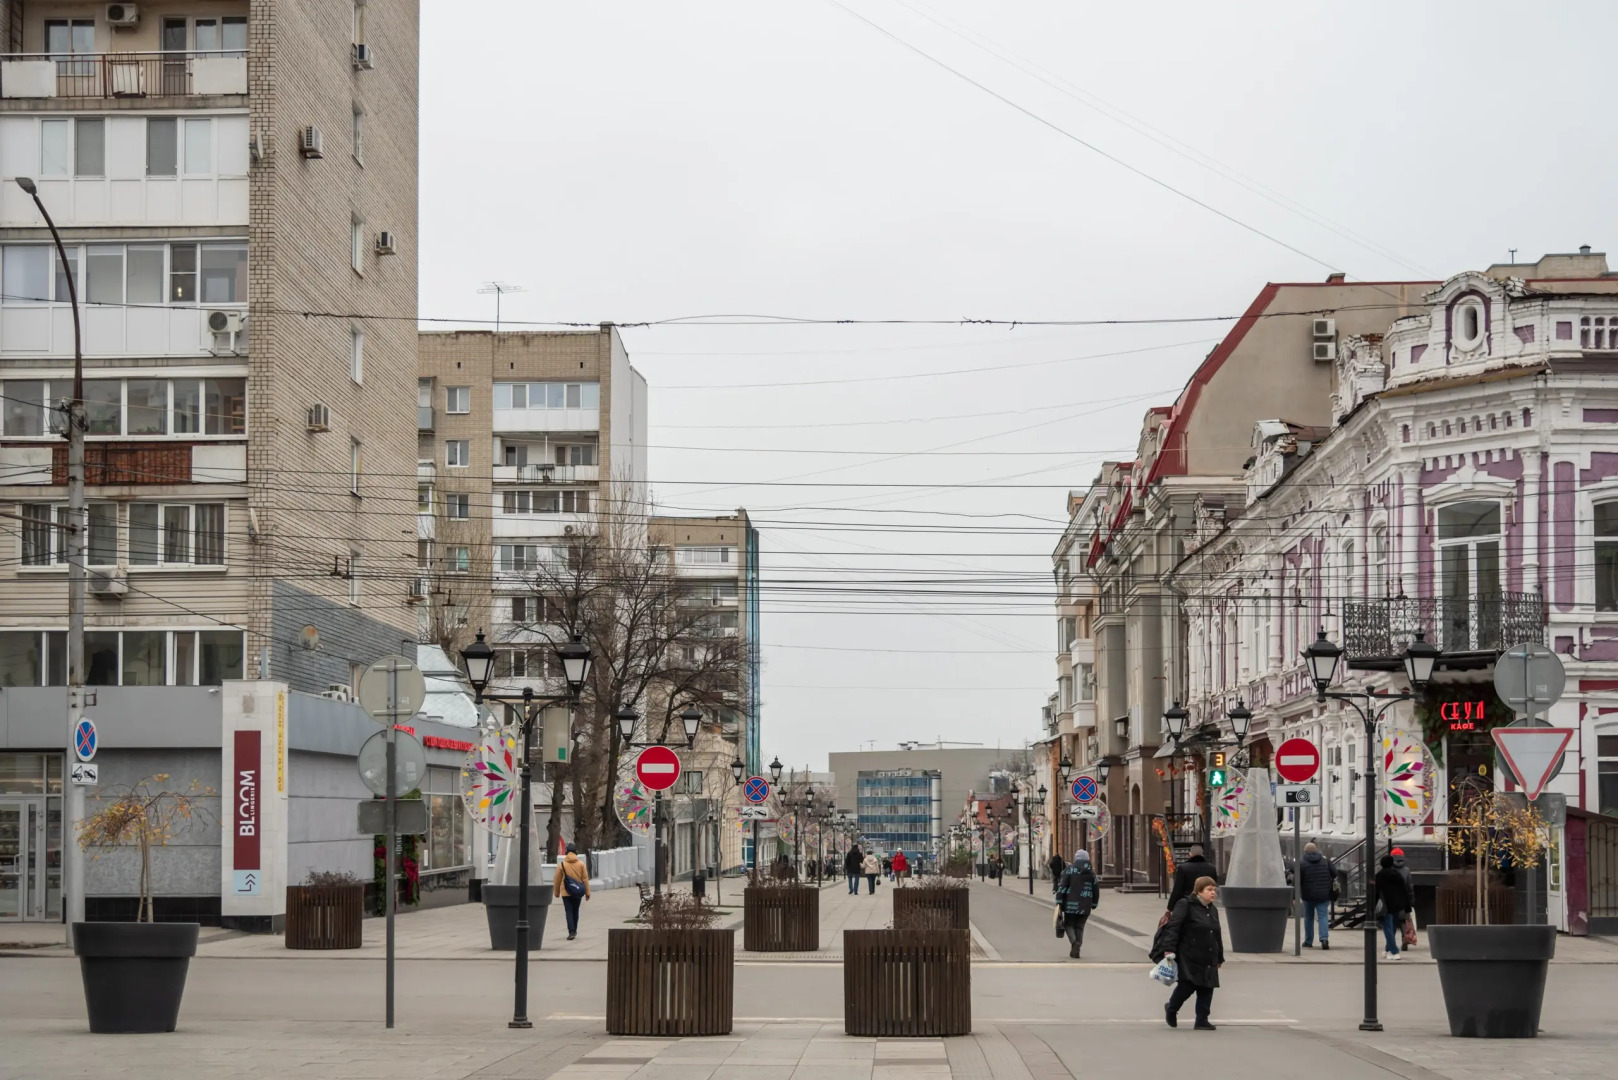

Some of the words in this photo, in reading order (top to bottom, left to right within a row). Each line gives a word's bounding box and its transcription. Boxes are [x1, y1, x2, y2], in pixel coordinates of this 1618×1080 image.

[1440, 700, 1484, 720] СЕУЛ
[1450, 722, 1474, 730] КАФЕ
[1215, 754, 1223, 766] 3
[239, 770, 256, 836] BLOOM
